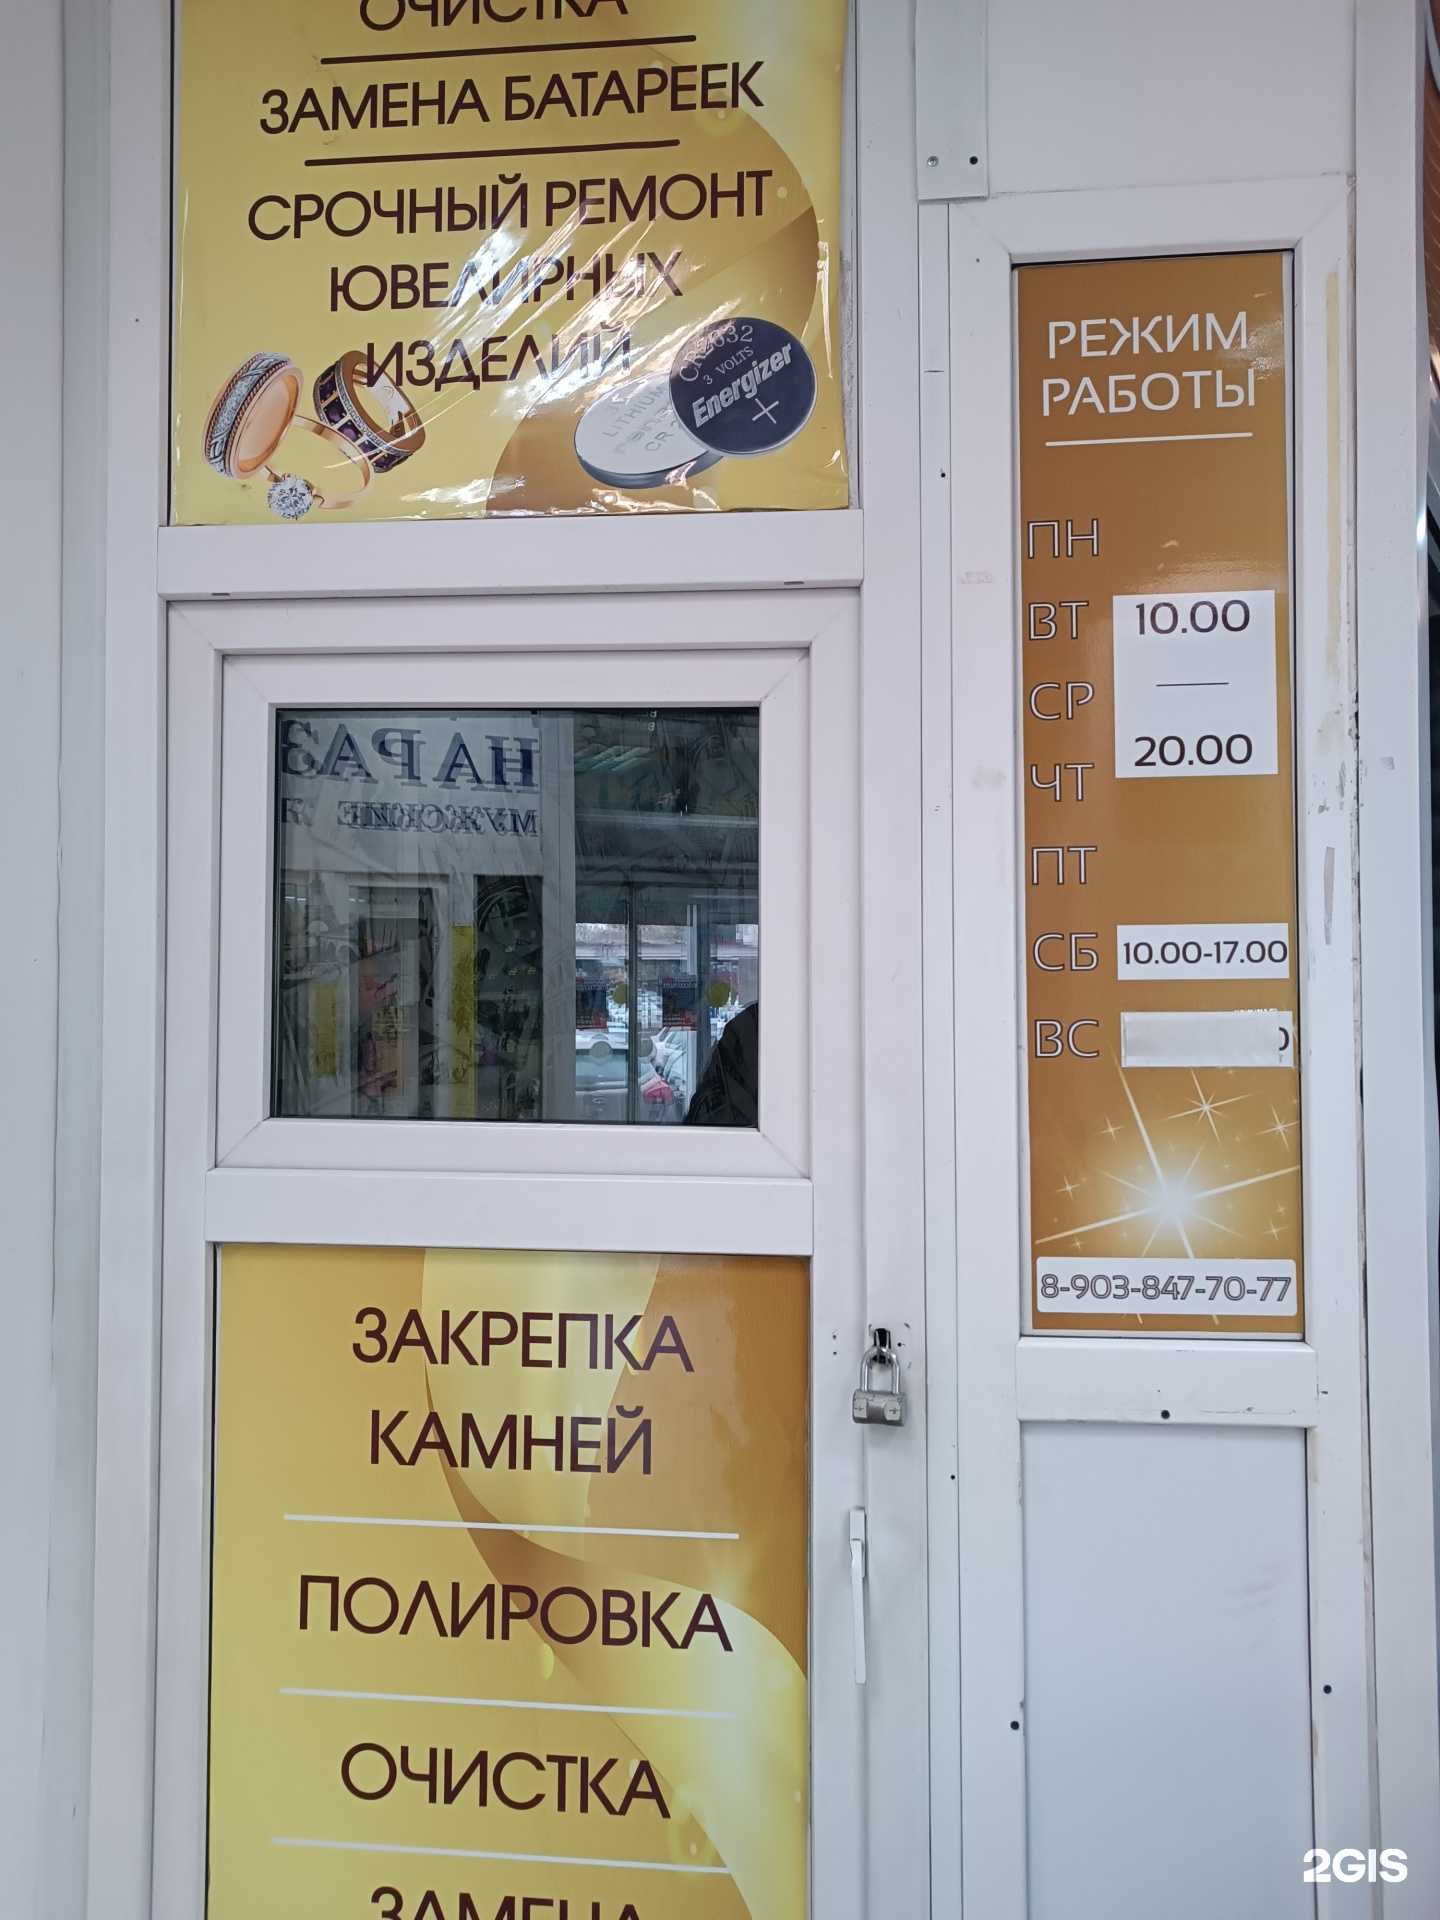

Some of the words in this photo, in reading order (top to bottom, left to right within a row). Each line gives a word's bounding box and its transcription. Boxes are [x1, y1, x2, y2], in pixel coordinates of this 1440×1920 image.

[259, 77, 491, 135] ЗАМЕНА
[503, 60, 764, 123] БАТАРЕЕК
[248, 172, 528, 241] СРОЧНЫЙ
[545, 169, 773, 227] РЕМОНТ
[679, 318, 754, 383] CR2032
[1049, 311, 1248, 359] РЕЖИМ
[366, 321, 632, 392] ИЗДЕЛИЙ
[703, 374, 713, 385] 3
[716, 345, 754, 376] VOLTS
[690, 342, 793, 429] Energizer
[1042, 368, 1256, 417] РАБОТЫ
[1027, 517, 1100, 558] ПН
[1028, 600, 1089, 641] ВТ
[1136, 599, 1251, 636] 10.00
[1029, 681, 1095, 720] СР
[1134, 733, 1253, 767] 20.00
[1030, 761, 1095, 801] ЧТ
[1031, 845, 1098, 885] ПТ
[1032, 932, 1100, 972] СБ
[1123, 939, 1288, 965] 10.00-17.00
[1033, 1019, 1100, 1058] ВС
[1040, 1273, 1292, 1303] 8-903-847-70-77
[352, 1307, 694, 1373] ЗАКРЕПКА
[369, 1404, 653, 1475] КАМНЕЙ
[299, 1574, 733, 1652] ПОЛИРОВКА
[340, 1742, 671, 1819] ОЧИСТКА
